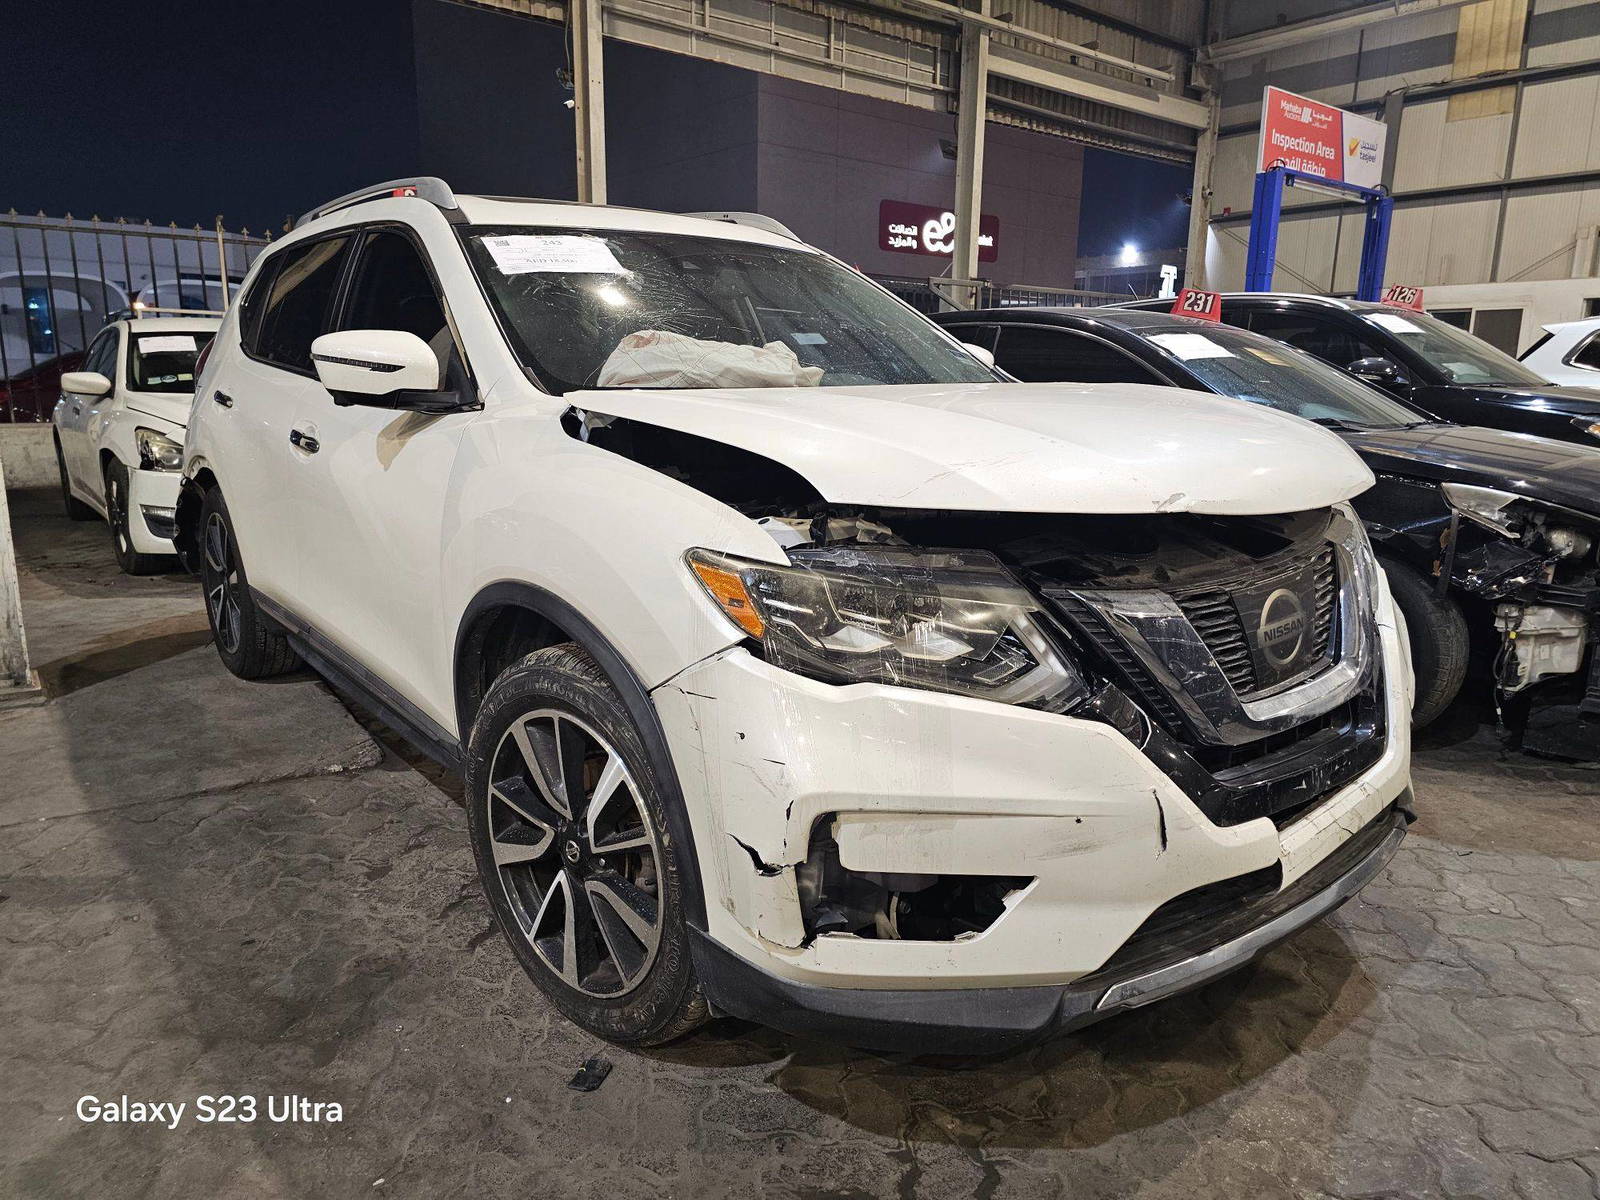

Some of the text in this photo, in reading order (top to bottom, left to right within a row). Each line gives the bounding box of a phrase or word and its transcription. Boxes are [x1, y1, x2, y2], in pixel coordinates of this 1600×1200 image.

[1271, 128, 1336, 160] Inspection Area
[1183, 292, 1214, 314] 231
[1392, 286, 1416, 304] 126
[1263, 617, 1304, 642] NISSAN
